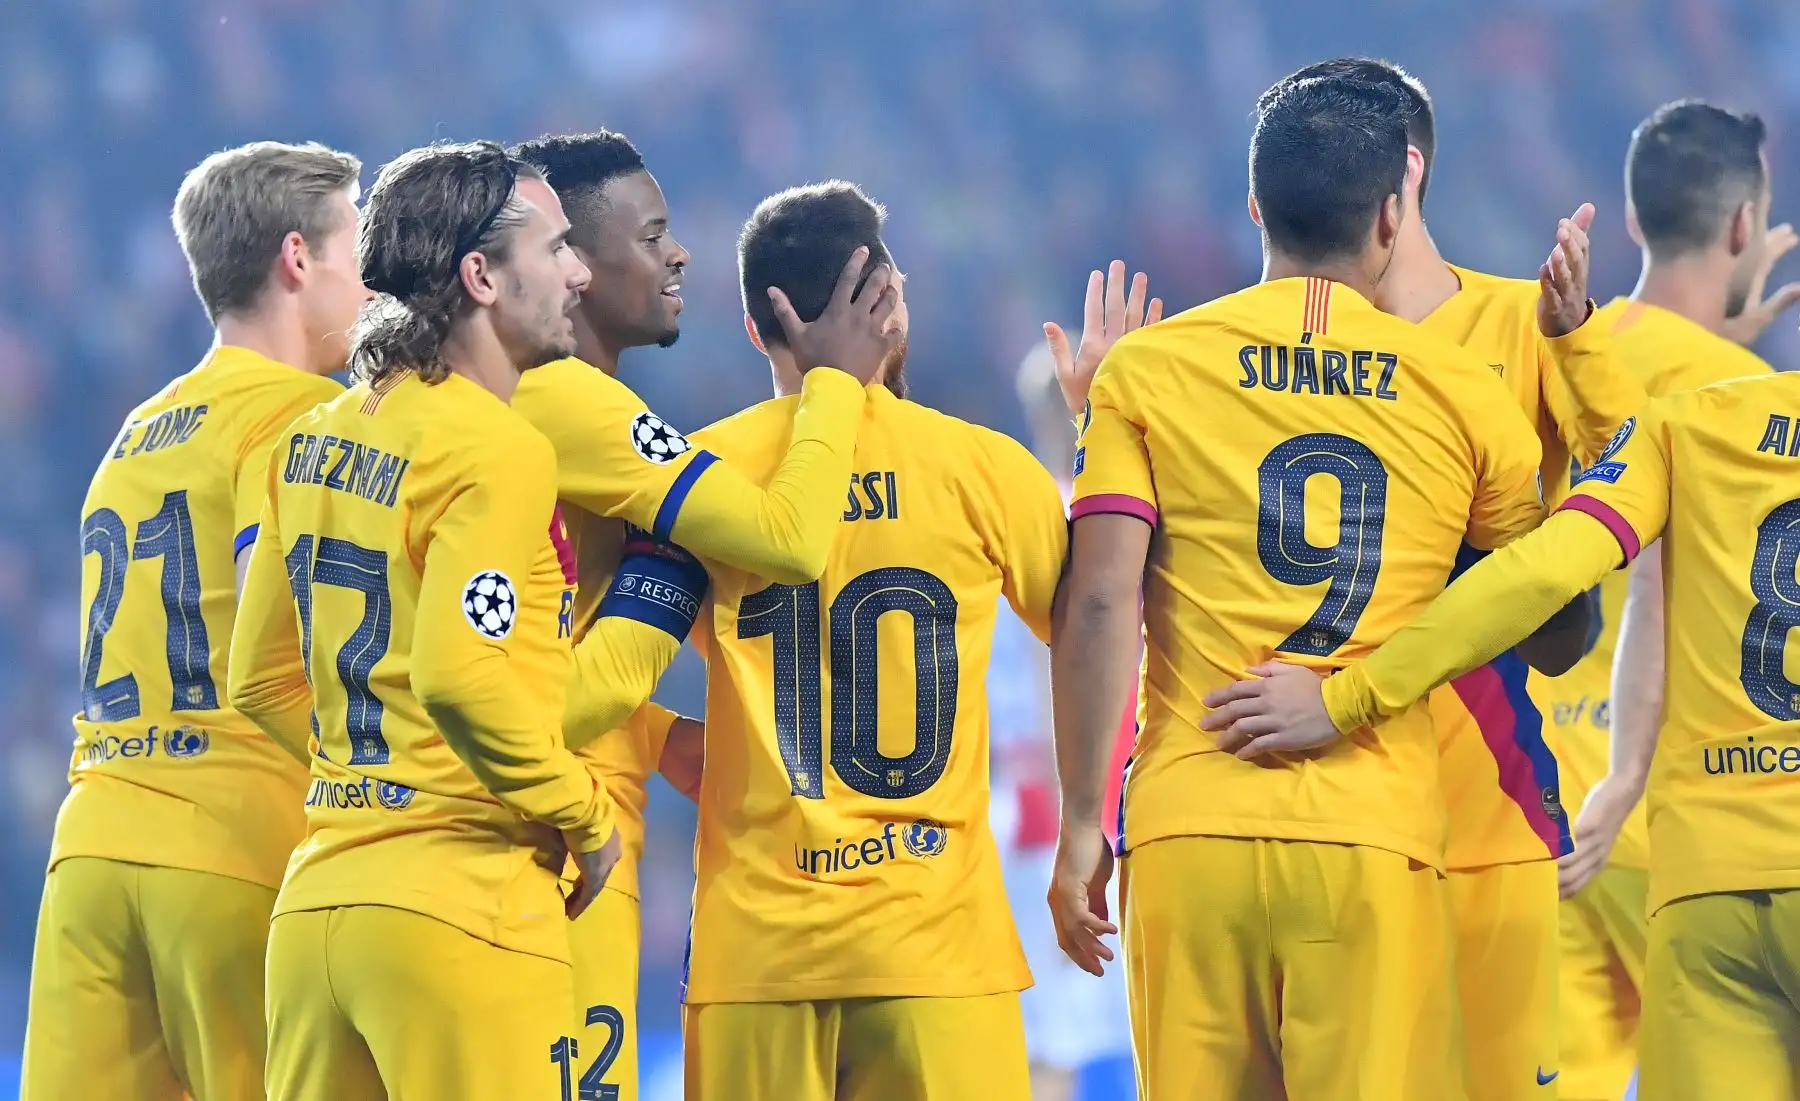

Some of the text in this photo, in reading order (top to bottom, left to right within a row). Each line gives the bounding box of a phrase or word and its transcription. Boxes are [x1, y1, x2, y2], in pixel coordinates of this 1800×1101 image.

[1239, 332, 1398, 400] SUÁREZ
[131, 404, 209, 456] JONG
[840, 471, 898, 522] SSI
[1257, 433, 1388, 657] 9
[80, 489, 220, 722] 21
[285, 534, 391, 765] 17
[737, 566, 958, 800] 10
[82, 726, 159, 763] unicef
[1704, 736, 1800, 775] unice
[306, 776, 371, 809] unicef
[795, 823, 896, 874] unicef
